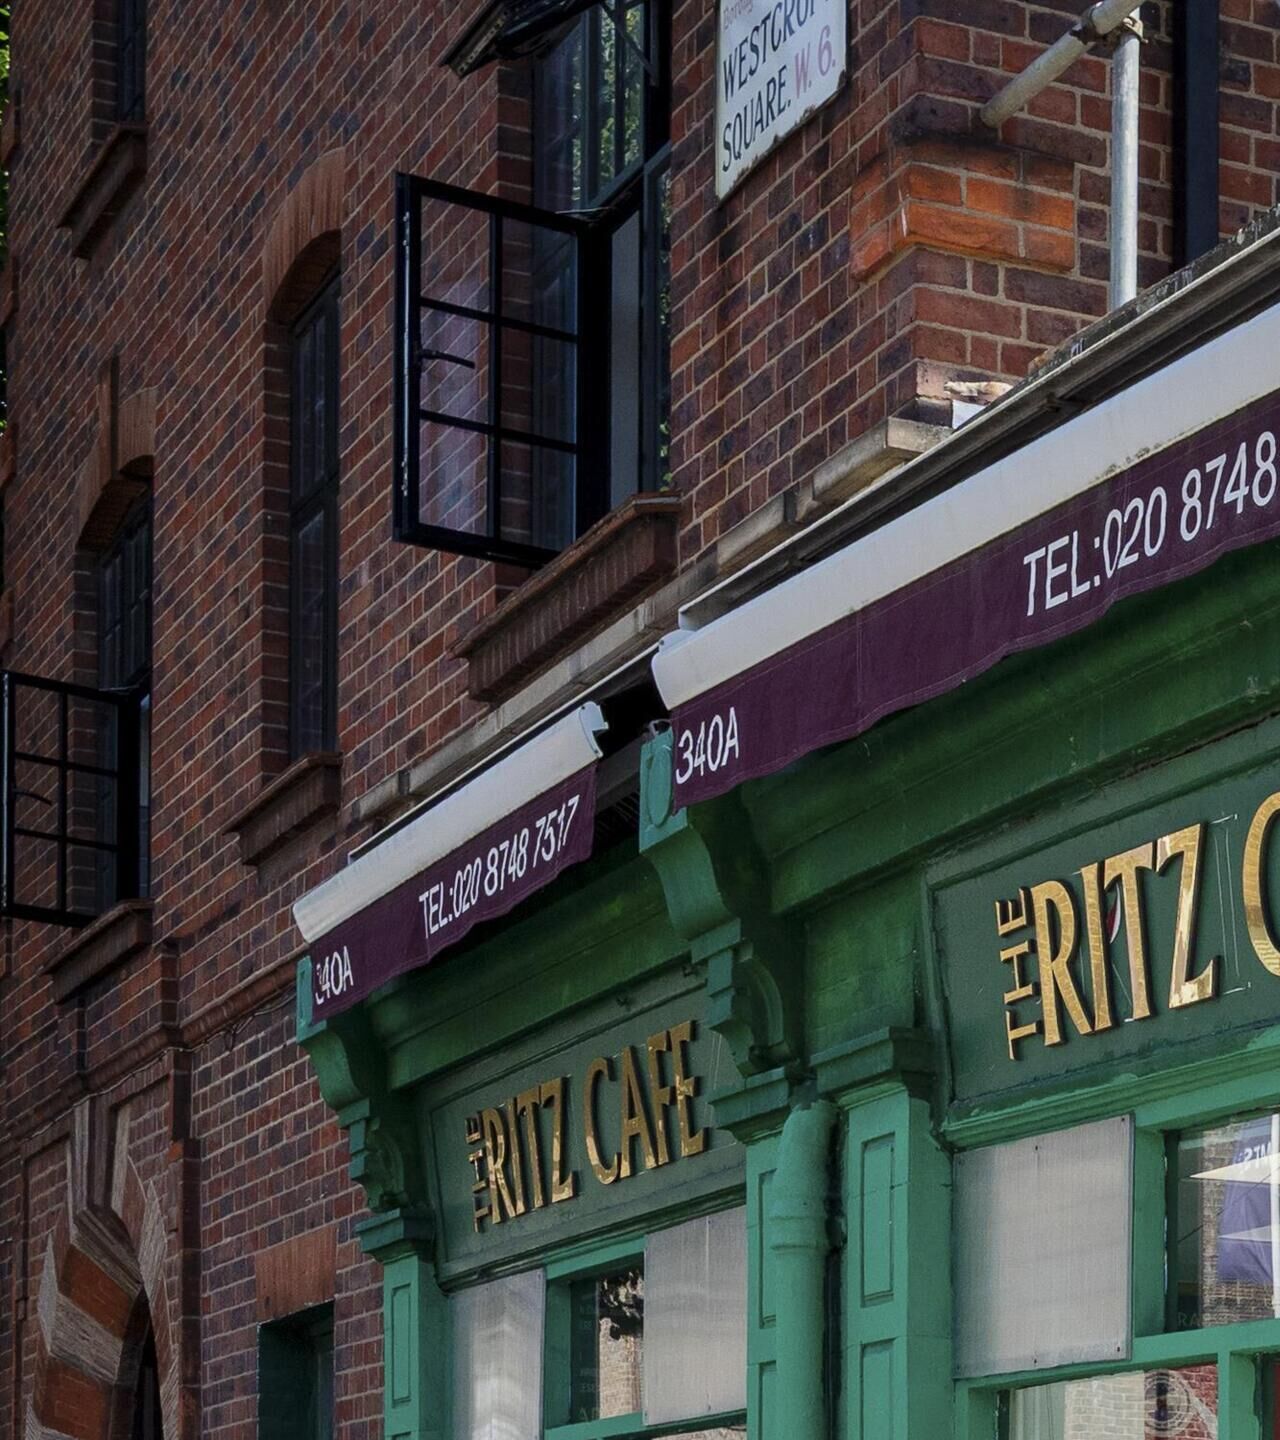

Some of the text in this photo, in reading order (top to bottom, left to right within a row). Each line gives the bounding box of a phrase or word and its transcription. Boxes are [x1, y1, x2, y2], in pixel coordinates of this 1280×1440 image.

[723, 0, 828, 102] WESTCRO
[1022, 485, 1165, 616] TEL:020
[1179, 430, 1277, 542] 8748
[675, 706, 739, 785] 340A
[419, 795, 580, 939] TEL:020 8748 7517
[995, 887, 1042, 1062] THE
[1031, 822, 1219, 1047] RITZ
[465, 1020, 708, 1232] THE RITZ CAFE
